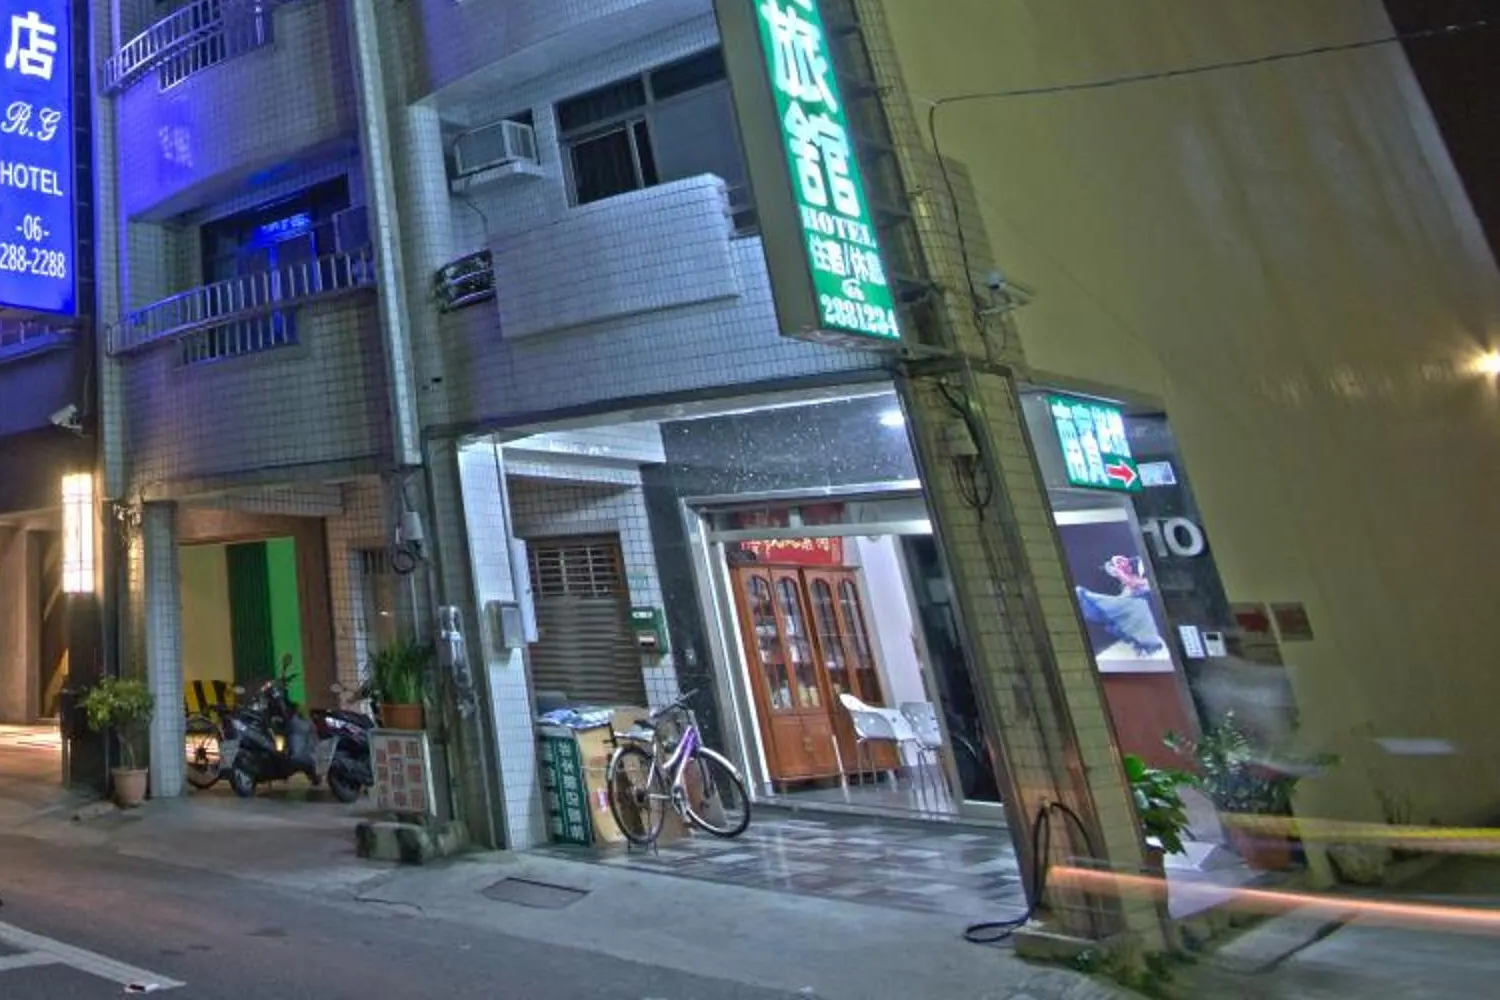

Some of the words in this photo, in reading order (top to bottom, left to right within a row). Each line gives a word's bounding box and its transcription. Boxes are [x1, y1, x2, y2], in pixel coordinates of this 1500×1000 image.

[0, 160, 63, 196] HOTEL
[801, 205, 877, 248] HOTEL
[0, 242, 66, 279] 288-2288
